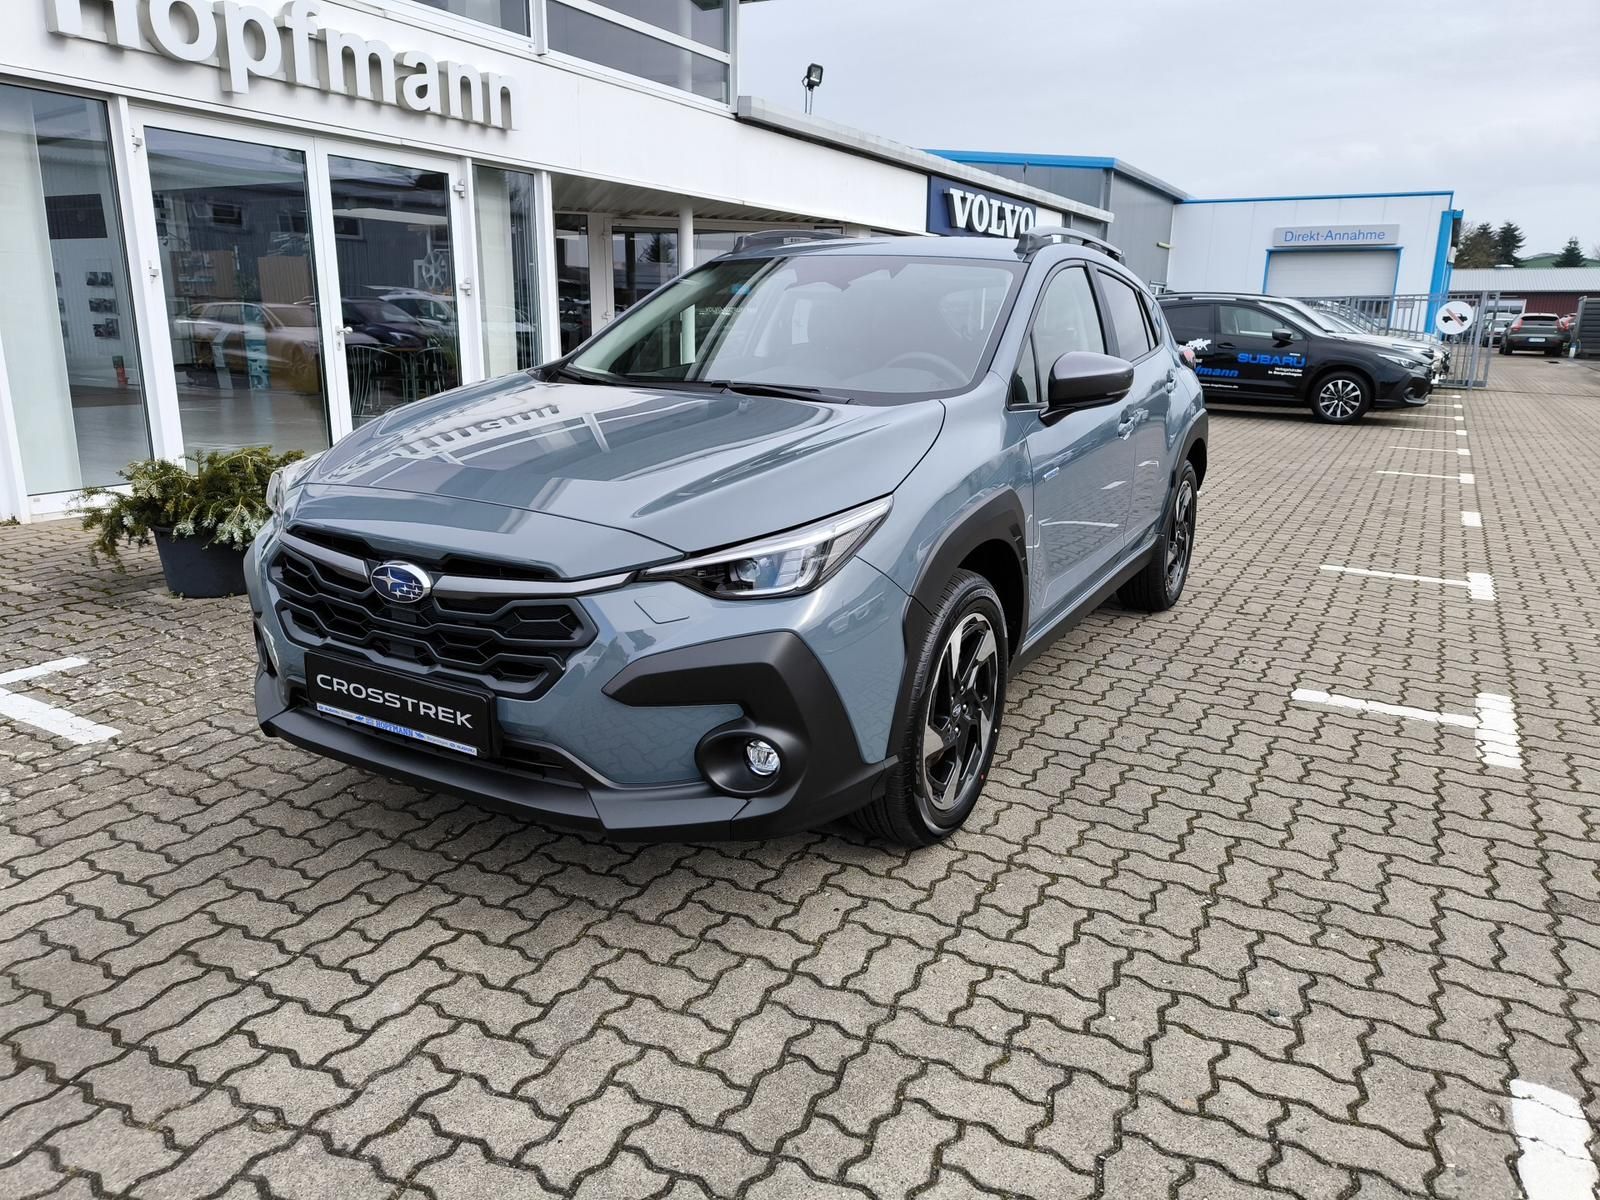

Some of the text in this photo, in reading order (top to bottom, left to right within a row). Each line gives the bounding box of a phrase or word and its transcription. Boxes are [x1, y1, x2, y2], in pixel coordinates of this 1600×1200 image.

[946, 187, 1034, 239] VOLVO
[1283, 229, 1386, 242] Direkt-Annahme
[1237, 352, 1306, 368] SUBARU
[316, 673, 473, 729] CROSSTREK
